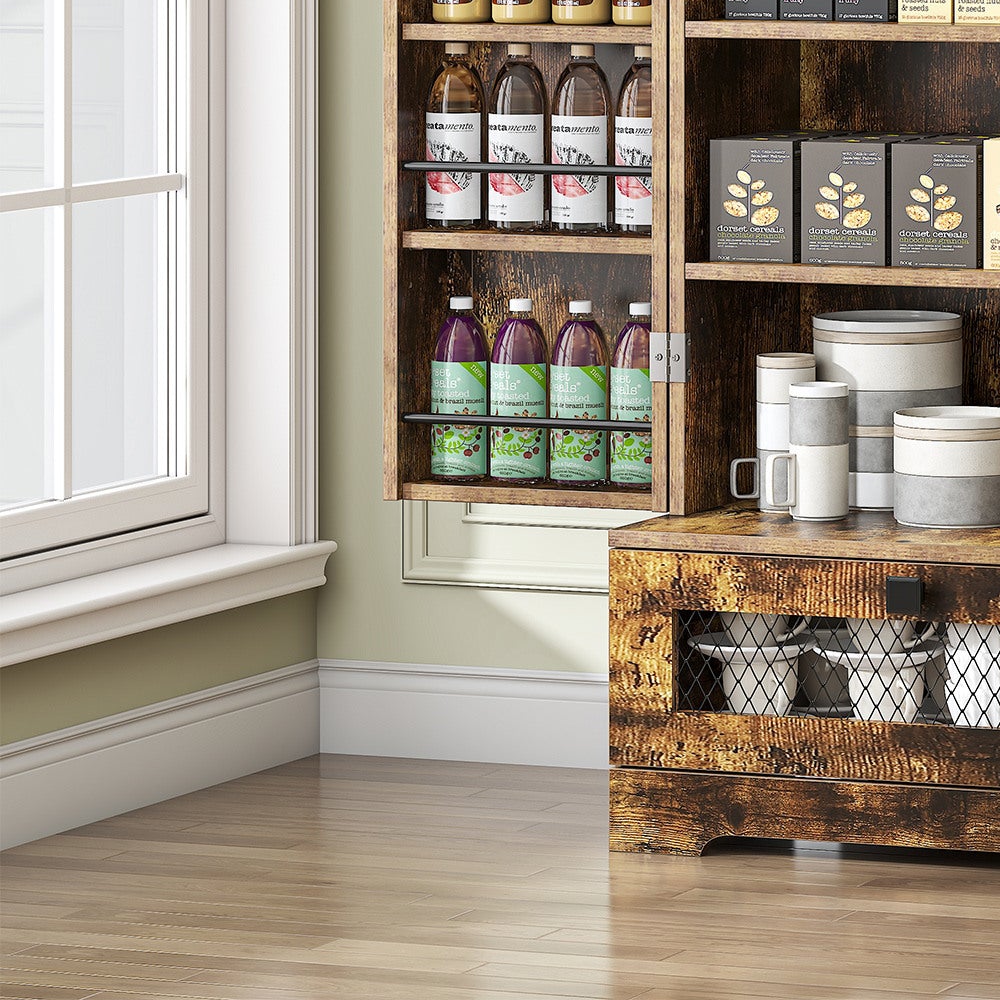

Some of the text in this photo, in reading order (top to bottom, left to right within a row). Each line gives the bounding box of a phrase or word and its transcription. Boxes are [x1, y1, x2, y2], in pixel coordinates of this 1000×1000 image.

[717, 225, 747, 233] dorset
[808, 227, 877, 236] dorset cereals
[900, 230, 931, 238] dorset
[471, 365, 485, 379] new
[530, 367, 545, 381] new
[590, 368, 605, 383] new
[437, 390, 470, 398] toasted
